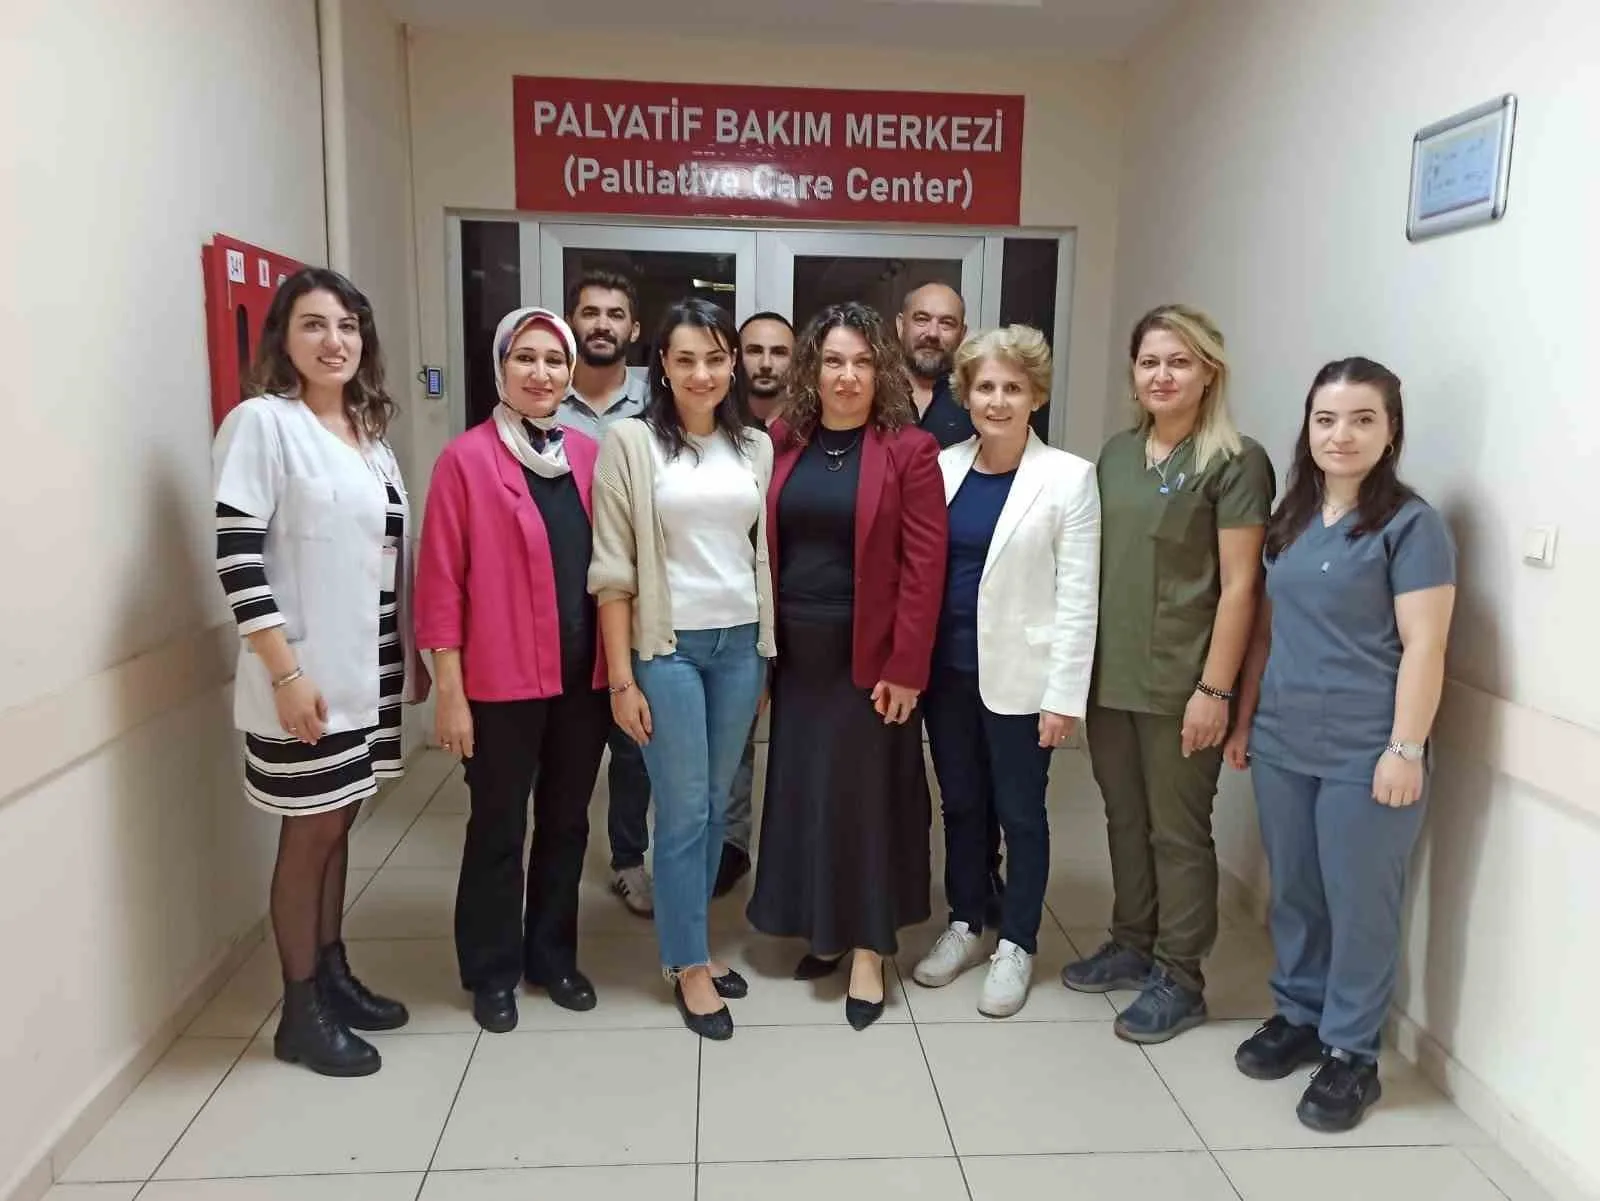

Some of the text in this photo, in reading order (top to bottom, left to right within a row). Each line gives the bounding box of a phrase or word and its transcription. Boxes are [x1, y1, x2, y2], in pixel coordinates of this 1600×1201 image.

[534, 97, 1002, 152] PALYATİF BAKIM MERKEZİ
[564, 154, 973, 210] (Palliative Care Center)
